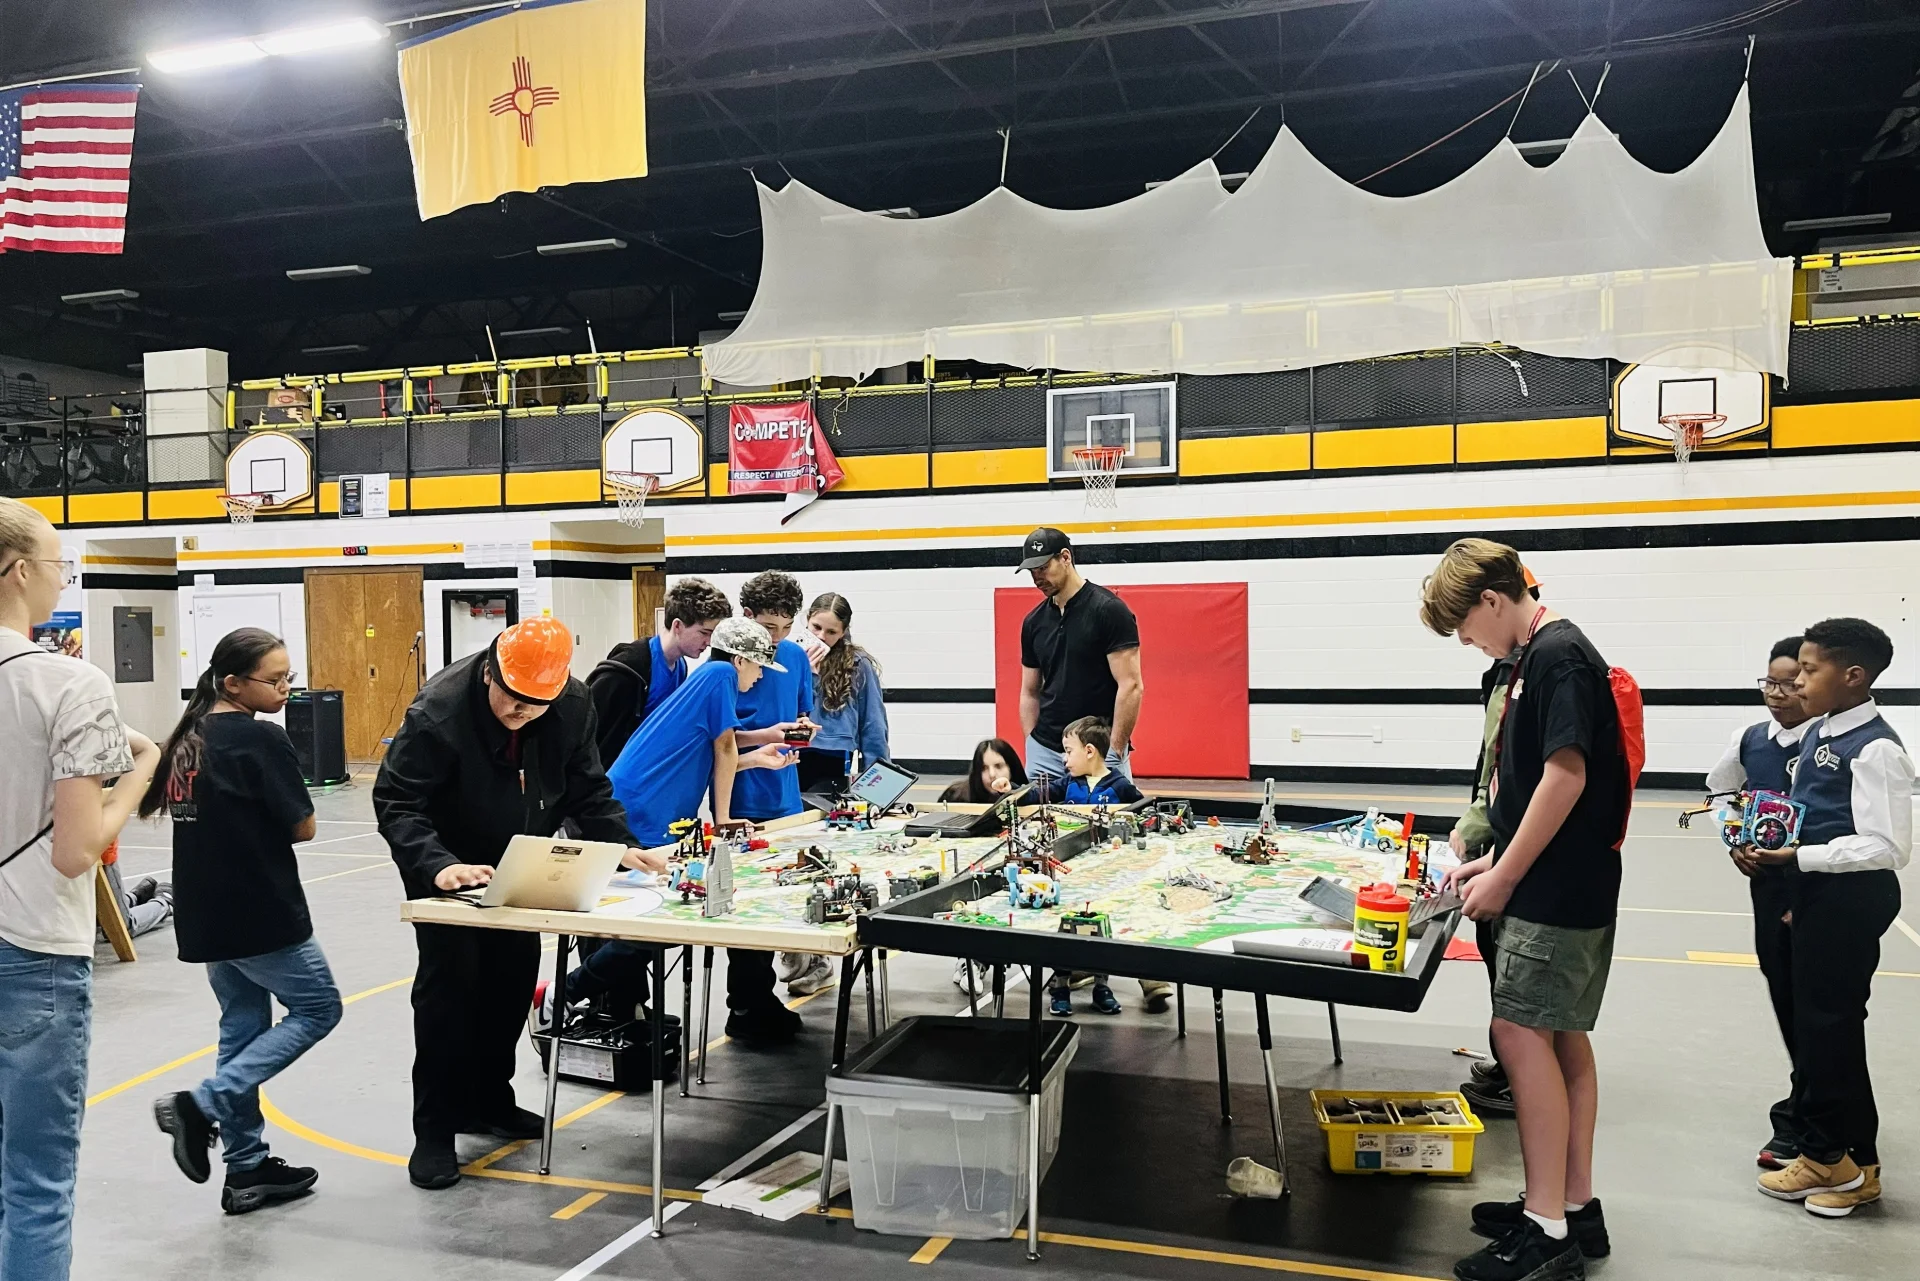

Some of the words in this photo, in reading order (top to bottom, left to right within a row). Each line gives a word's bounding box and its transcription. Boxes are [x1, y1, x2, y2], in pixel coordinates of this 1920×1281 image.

[734, 419, 808, 442] COMPETE
[733, 471, 771, 480] RESPECT
[775, 466, 806, 479] INTEGRY
